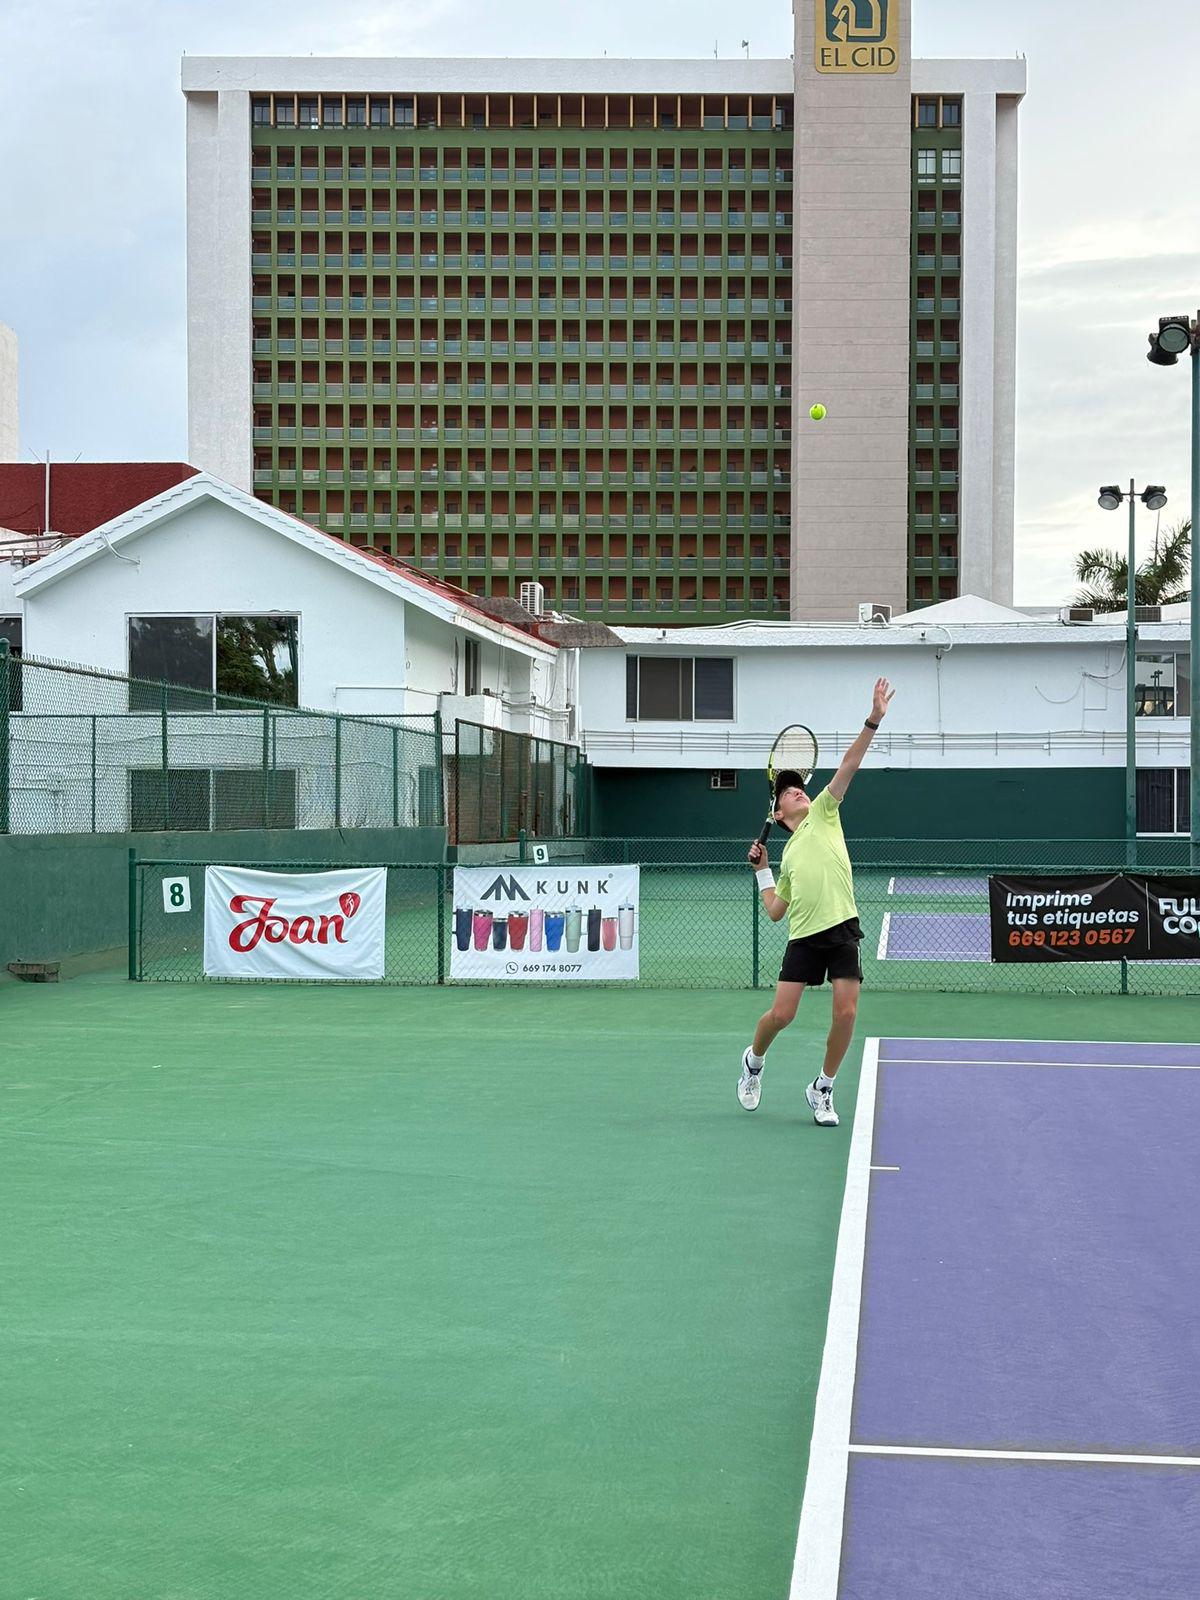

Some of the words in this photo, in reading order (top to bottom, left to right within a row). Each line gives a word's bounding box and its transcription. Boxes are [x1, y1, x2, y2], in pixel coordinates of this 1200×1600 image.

[821, 47, 847, 67] EL
[851, 47, 896, 67] CID
[536, 847, 545, 861] 9
[169, 882, 185, 907] 8
[536, 880, 609, 895] KUNK
[1005, 890, 1093, 912] Imprime
[228, 894, 349, 953] Joan
[1007, 910, 1038, 926] tus
[1042, 908, 1139, 930] etiquetas
[1008, 930, 1046, 947] 669
[1050, 930, 1080, 947] 123
[1084, 928, 1136, 946] 0567
[522, 964, 540, 973] 669
[542, 964, 557, 973] 174
[559, 964, 582, 973] 8077
